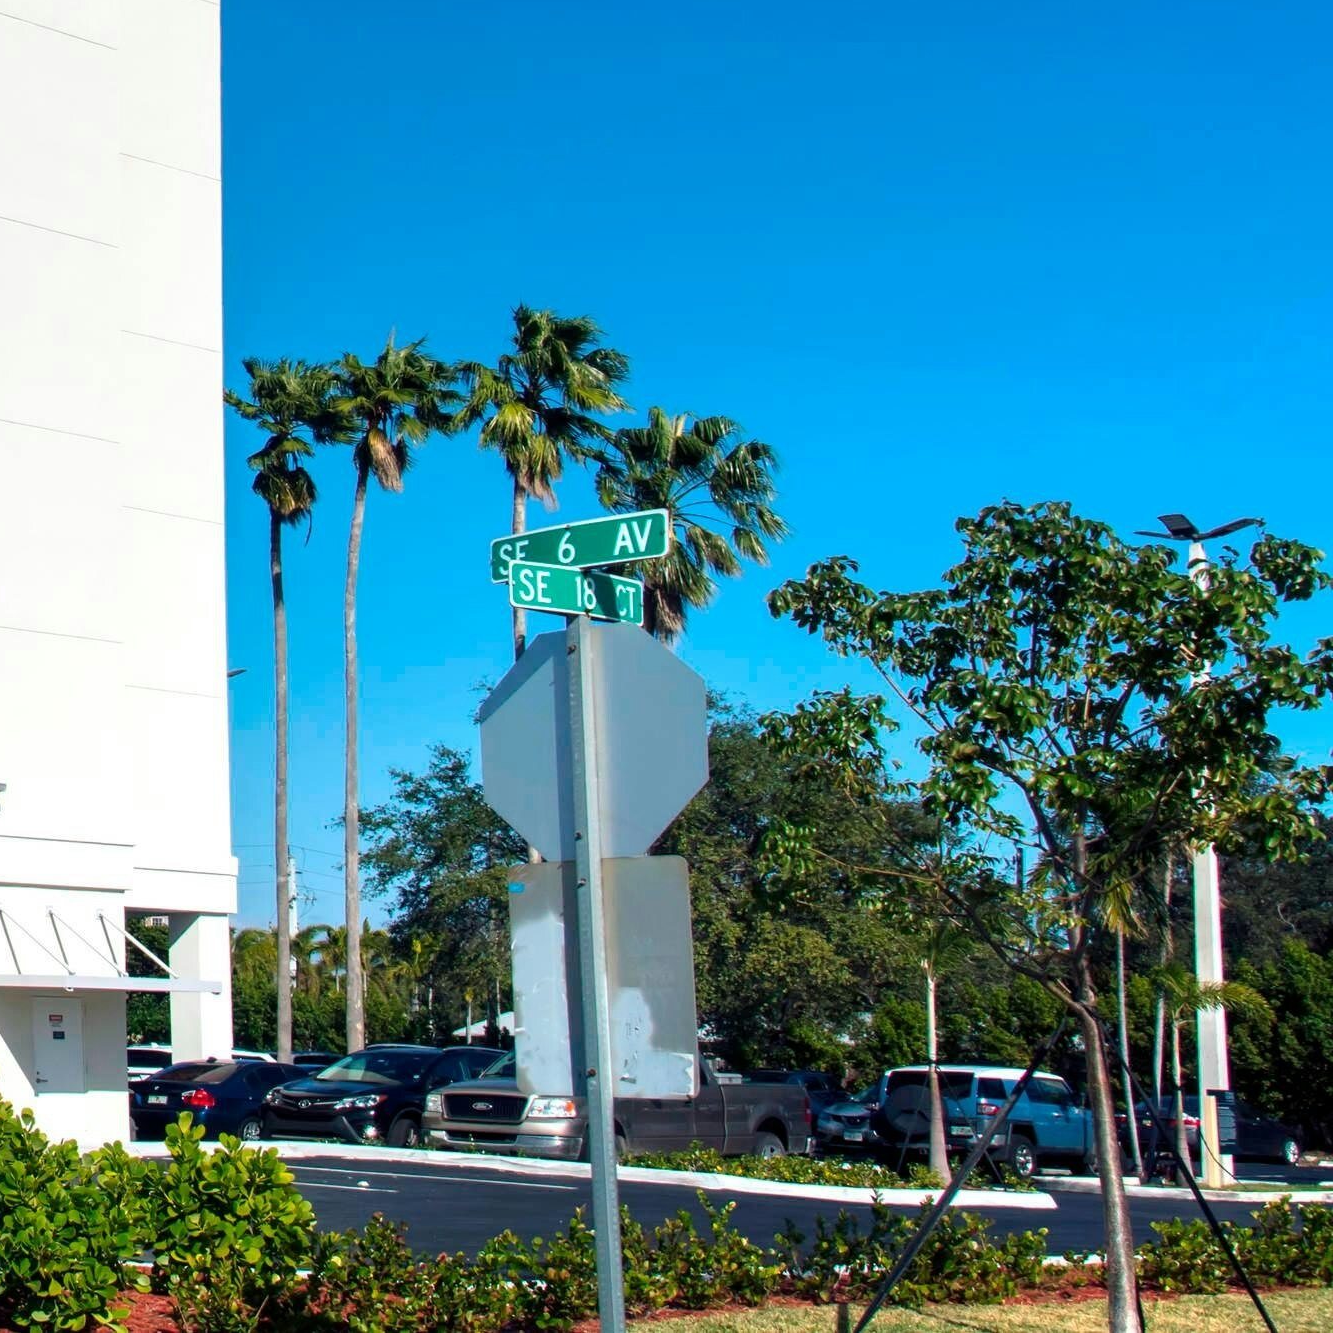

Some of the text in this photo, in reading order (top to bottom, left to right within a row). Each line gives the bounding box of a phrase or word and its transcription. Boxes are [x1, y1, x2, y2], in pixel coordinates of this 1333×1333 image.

[557, 531, 576, 564] 6
[613, 519, 652, 556] AV
[519, 569, 636, 618] SE 18 CT
